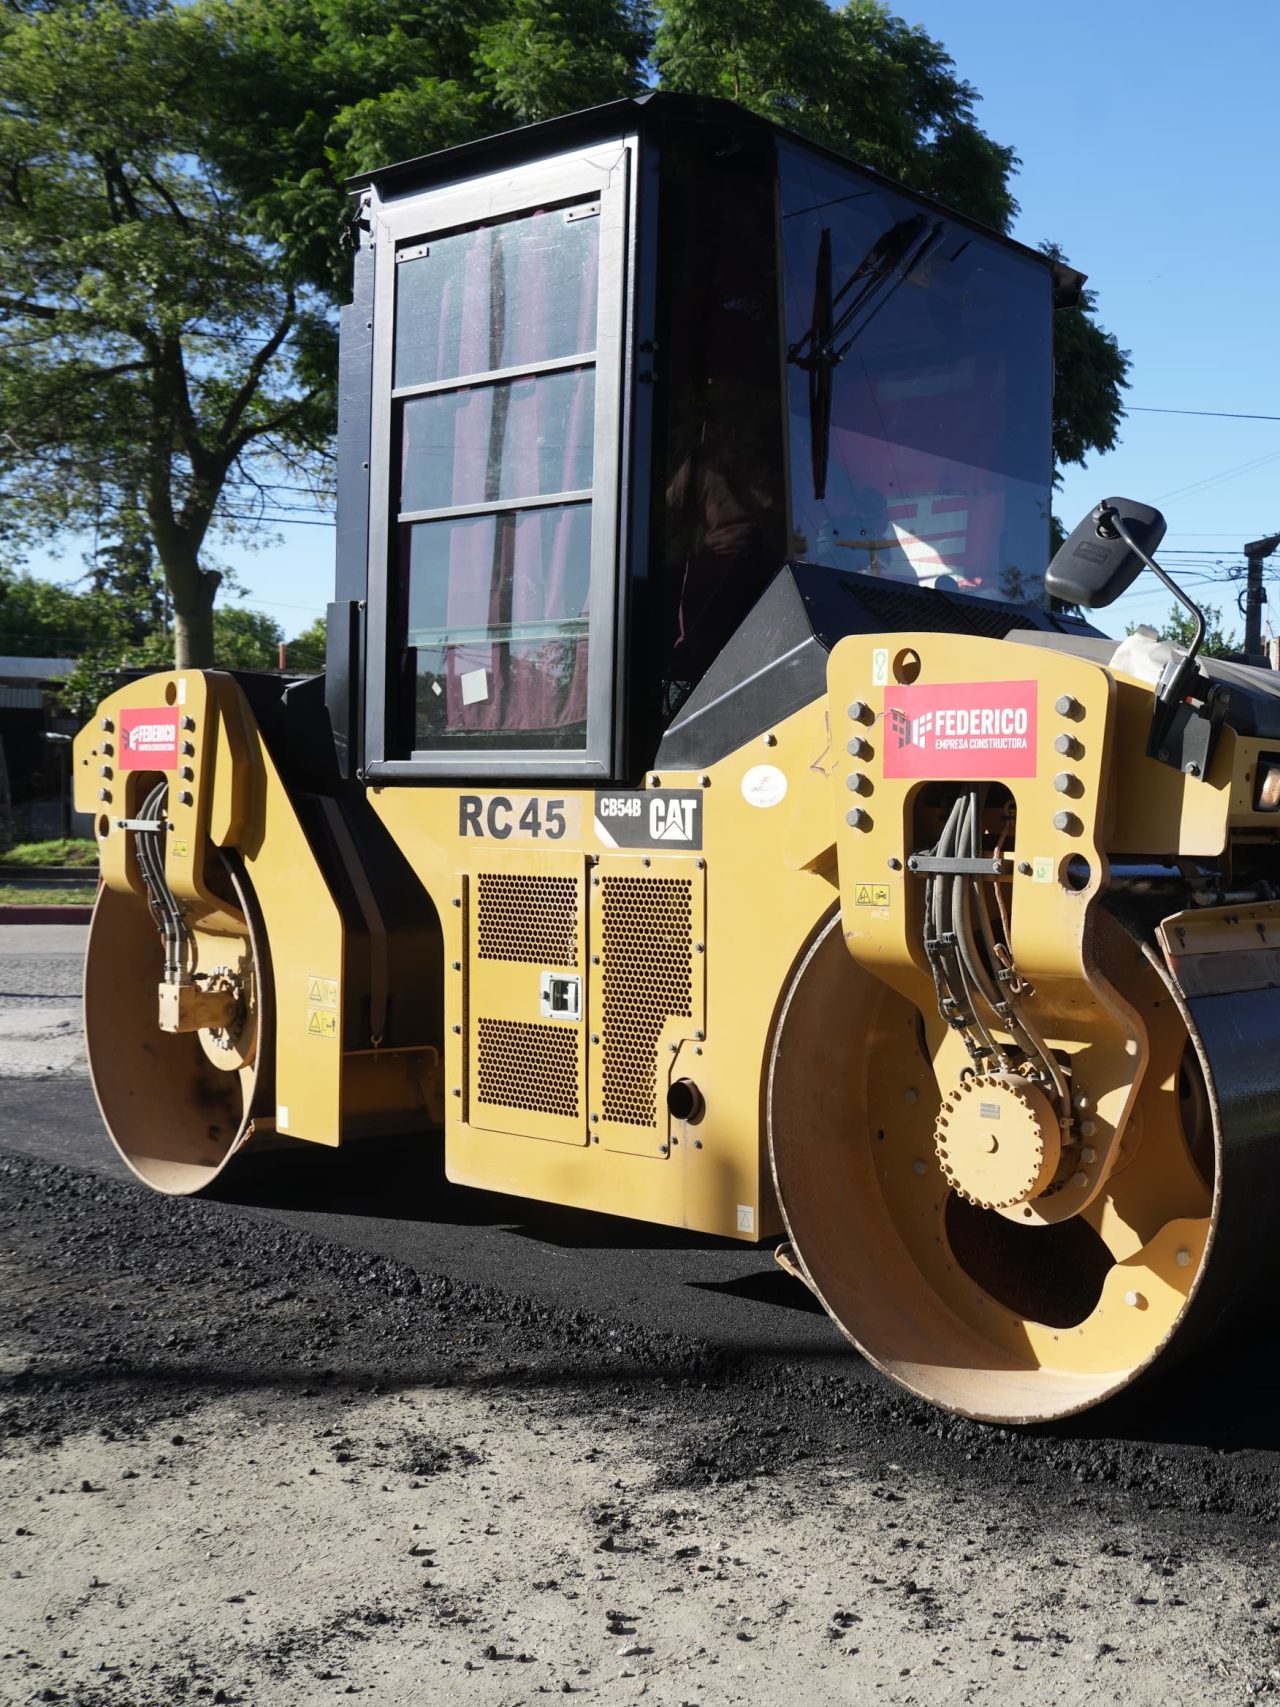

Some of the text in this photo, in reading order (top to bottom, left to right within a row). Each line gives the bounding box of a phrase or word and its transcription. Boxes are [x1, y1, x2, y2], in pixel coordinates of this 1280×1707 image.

[935, 707, 1028, 736] FEDERICO
[935, 737, 1027, 750] EMPRESA CONSTRUCTORA
[600, 797, 642, 817] CB54B
[649, 797, 697, 841] CAT
